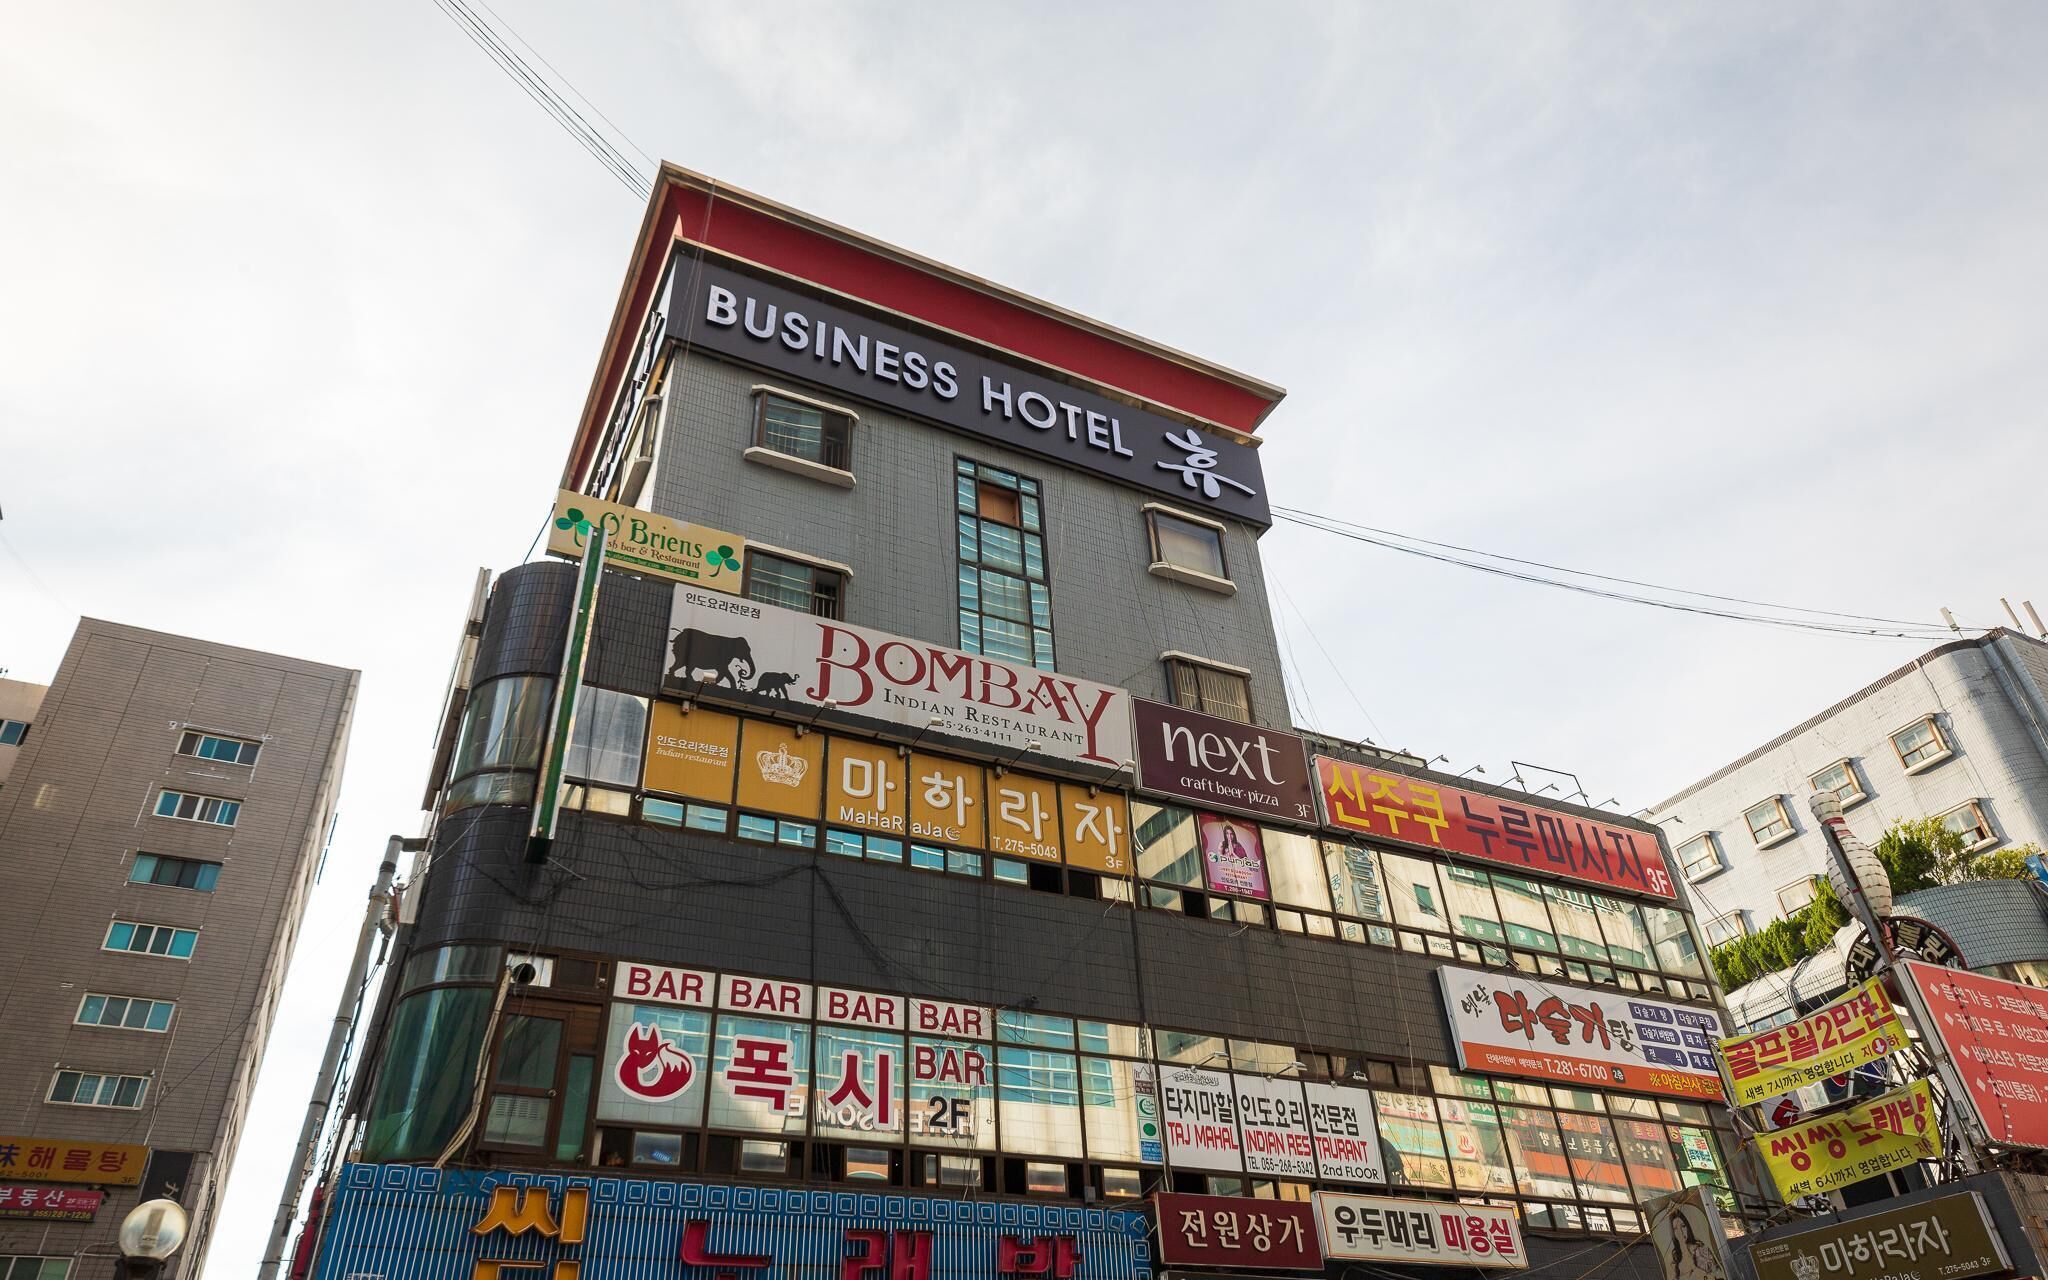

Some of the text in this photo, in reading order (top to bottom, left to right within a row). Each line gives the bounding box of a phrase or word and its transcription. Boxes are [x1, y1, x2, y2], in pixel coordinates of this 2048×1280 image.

[706, 284, 1134, 457] BUSINESS HOTEL
[1156, 428, 1257, 499] 휴
[620, 542, 636, 554] bar
[651, 549, 700, 569] Restaurant
[685, 592, 761, 619] 인도요리전문점
[805, 622, 1120, 767] BOMBAY
[656, 735, 729, 758] 인도요리전문점
[1162, 721, 1286, 785] next
[1180, 775, 1214, 793] craft
[1294, 803, 1311, 818] 3F
[1328, 765, 1648, 888] 신주쿠 누루마사지
[993, 836, 1057, 859] T.275-5043
[1105, 855, 1123, 869] 3F
[1647, 867, 1668, 894] 3F
[626, 966, 704, 1003] BAR
[730, 979, 801, 1014] BAR
[828, 991, 895, 1025] BAR
[919, 1003, 982, 1036] BAR
[914, 1045, 987, 1086] BAR
[1746, 1052, 1855, 1099] 새벽 7시까지 영업합니다
[928, 1095, 971, 1130] 2F
[1165, 1087, 1234, 1124] 타지마할
[1240, 1094, 1306, 1131] 인도요리
[1311, 1103, 1360, 1137] 전문점
[1167, 1121, 1191, 1147] TAJ
[1194, 1123, 1239, 1151] MAHAL
[1244, 1129, 1285, 1156] INDIAN
[1322, 1163, 1380, 1180] 2nd FLOOR
[1789, 1146, 1914, 1195] 새벽 6시까지 영업합니다
[1180, 1209, 1305, 1253] 전원상가
[1334, 1205, 1515, 1255] 우두머리 미용실
[1819, 1215, 1950, 1276] 마하라자
